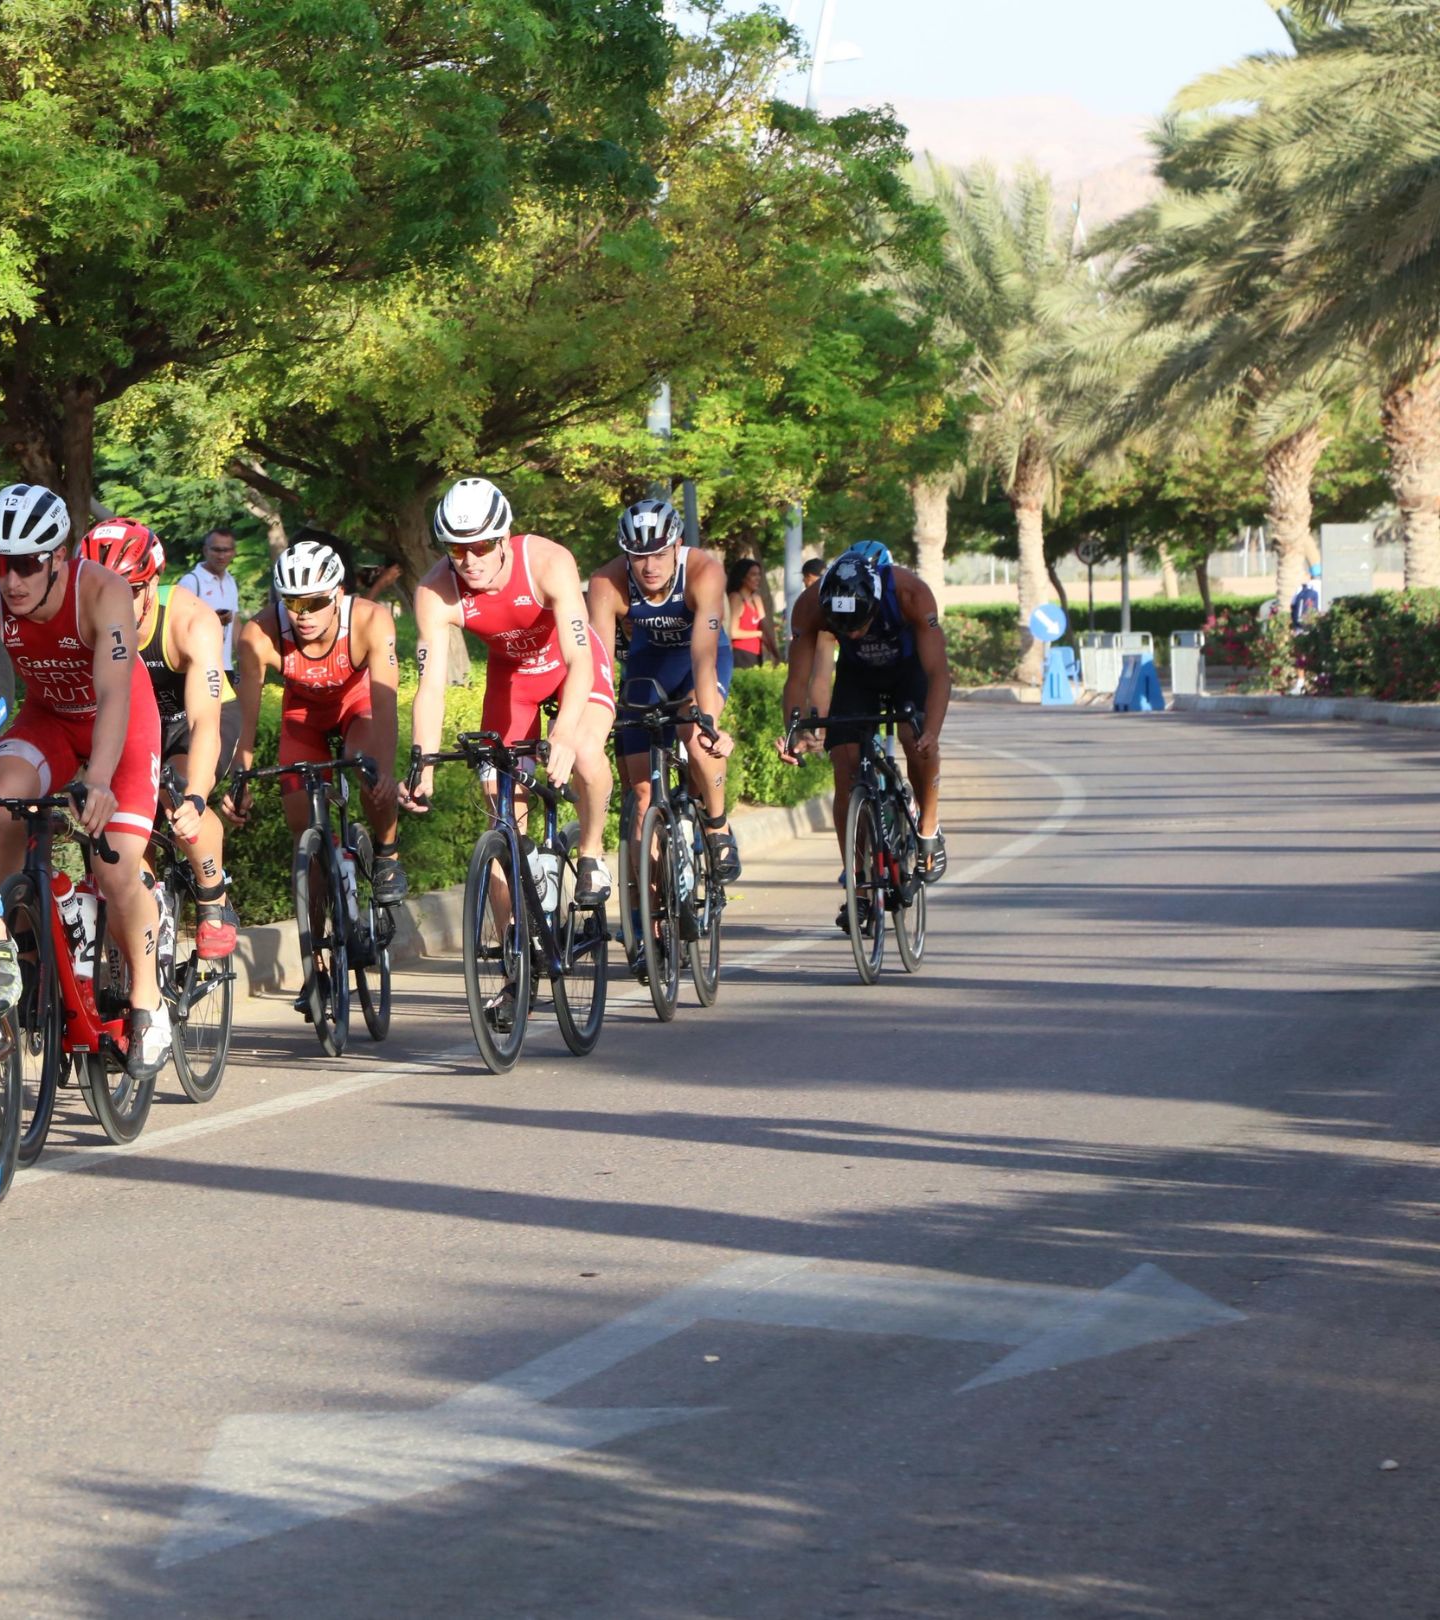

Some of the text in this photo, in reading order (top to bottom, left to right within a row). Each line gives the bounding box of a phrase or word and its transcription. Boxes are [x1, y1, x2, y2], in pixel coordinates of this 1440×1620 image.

[5, 498, 18, 506] 12
[457, 515, 469, 524] 32
[709, 619, 719, 631] 3
[112, 631, 127, 660] 12
[506, 637, 538, 650] AUT
[16, 656, 89, 669] Gastein
[206, 670, 220, 698] 25
[43, 686, 90, 701] AUT
